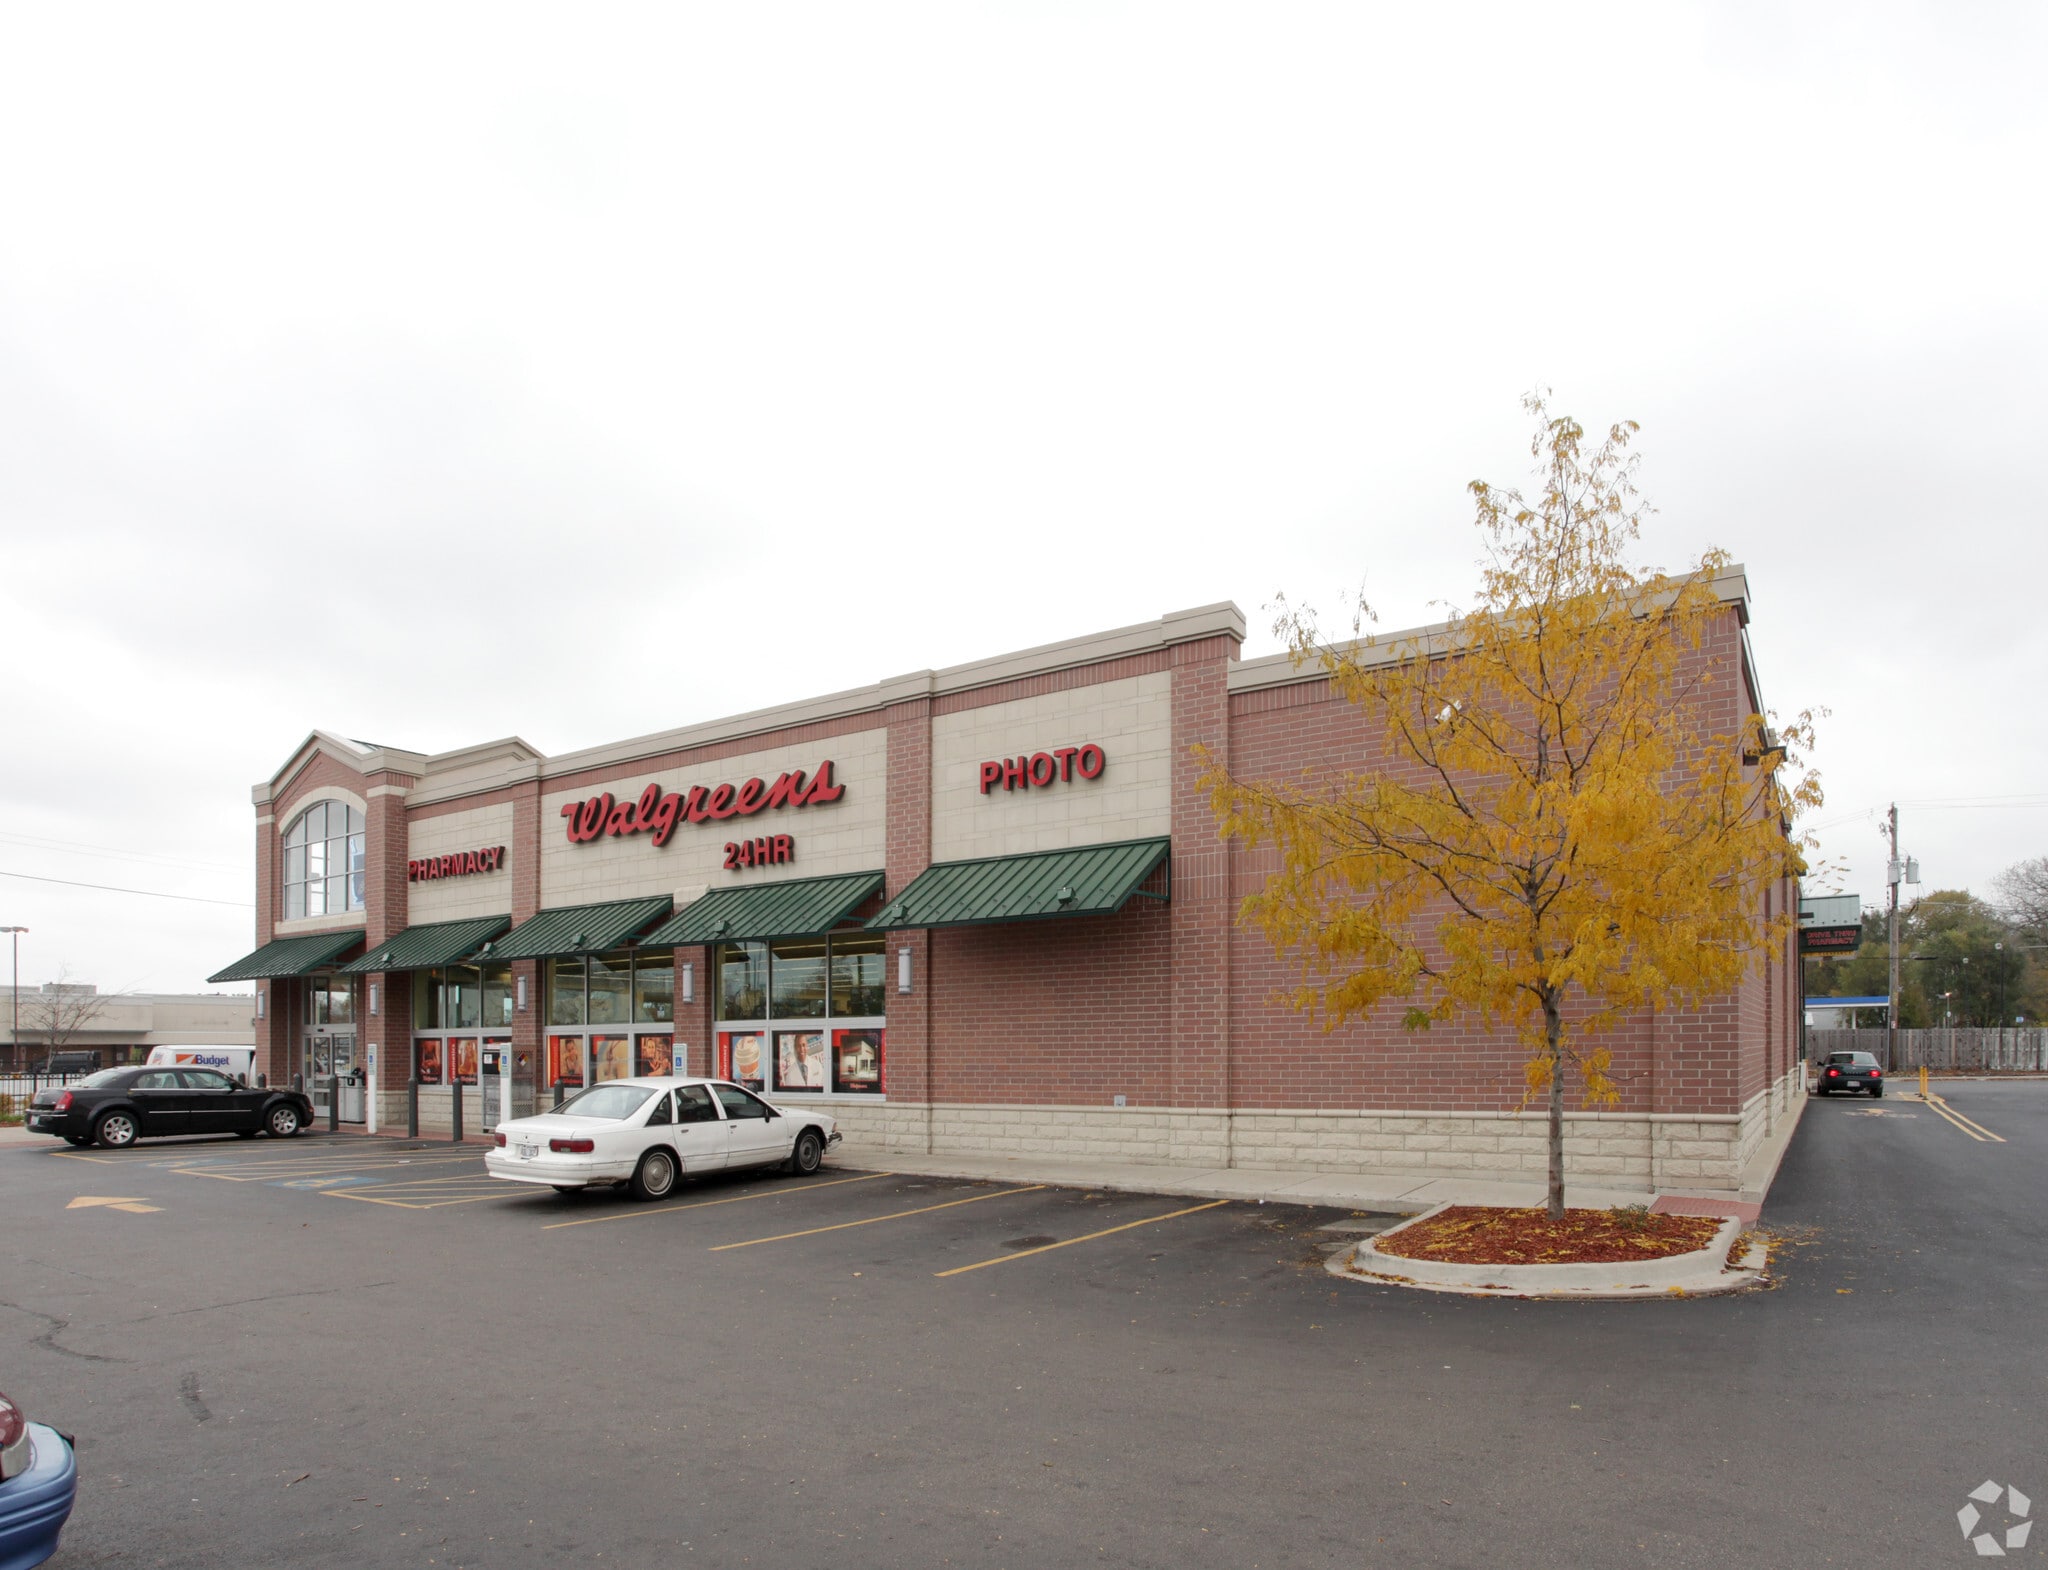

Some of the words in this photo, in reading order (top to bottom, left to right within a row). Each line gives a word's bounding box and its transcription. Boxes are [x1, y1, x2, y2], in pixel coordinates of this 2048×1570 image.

[980, 743, 1106, 795] PHOTO
[561, 760, 845, 847] Walgreens
[408, 846, 505, 883] PHARMACY
[723, 834, 794, 870] 24HR
[1807, 937, 1855, 946] PHARMACY
[195, 1054, 229, 1067] Budget
